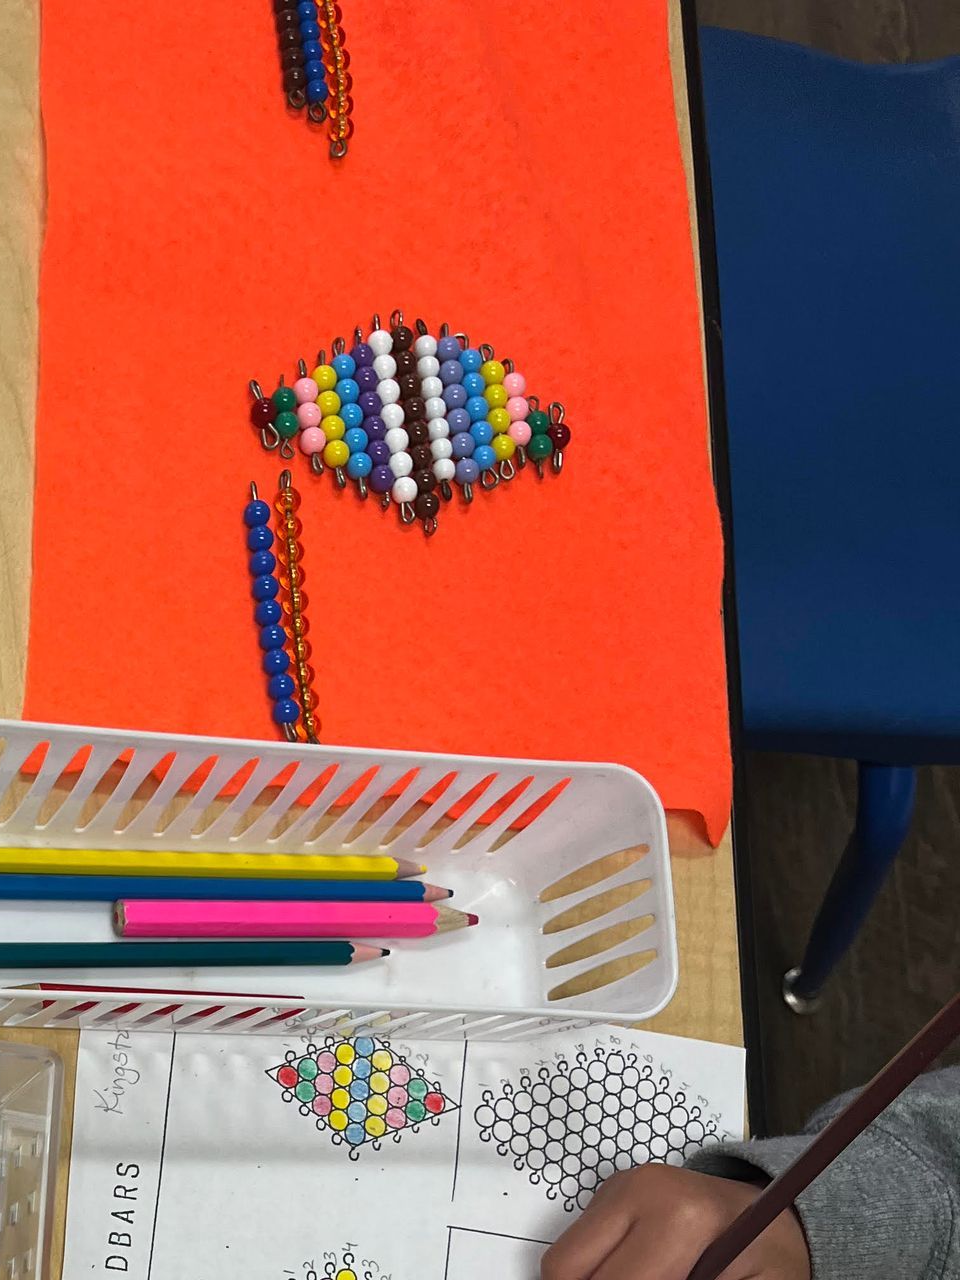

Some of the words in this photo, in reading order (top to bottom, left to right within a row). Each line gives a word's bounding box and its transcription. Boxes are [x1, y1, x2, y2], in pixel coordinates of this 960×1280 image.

[609, 1035, 621, 1045] 8
[302, 1260, 314, 1270] 2
[323, 1251, 337, 1266] 3
[341, 1242, 358, 1252] 4
[361, 1259, 379, 1272] 3
